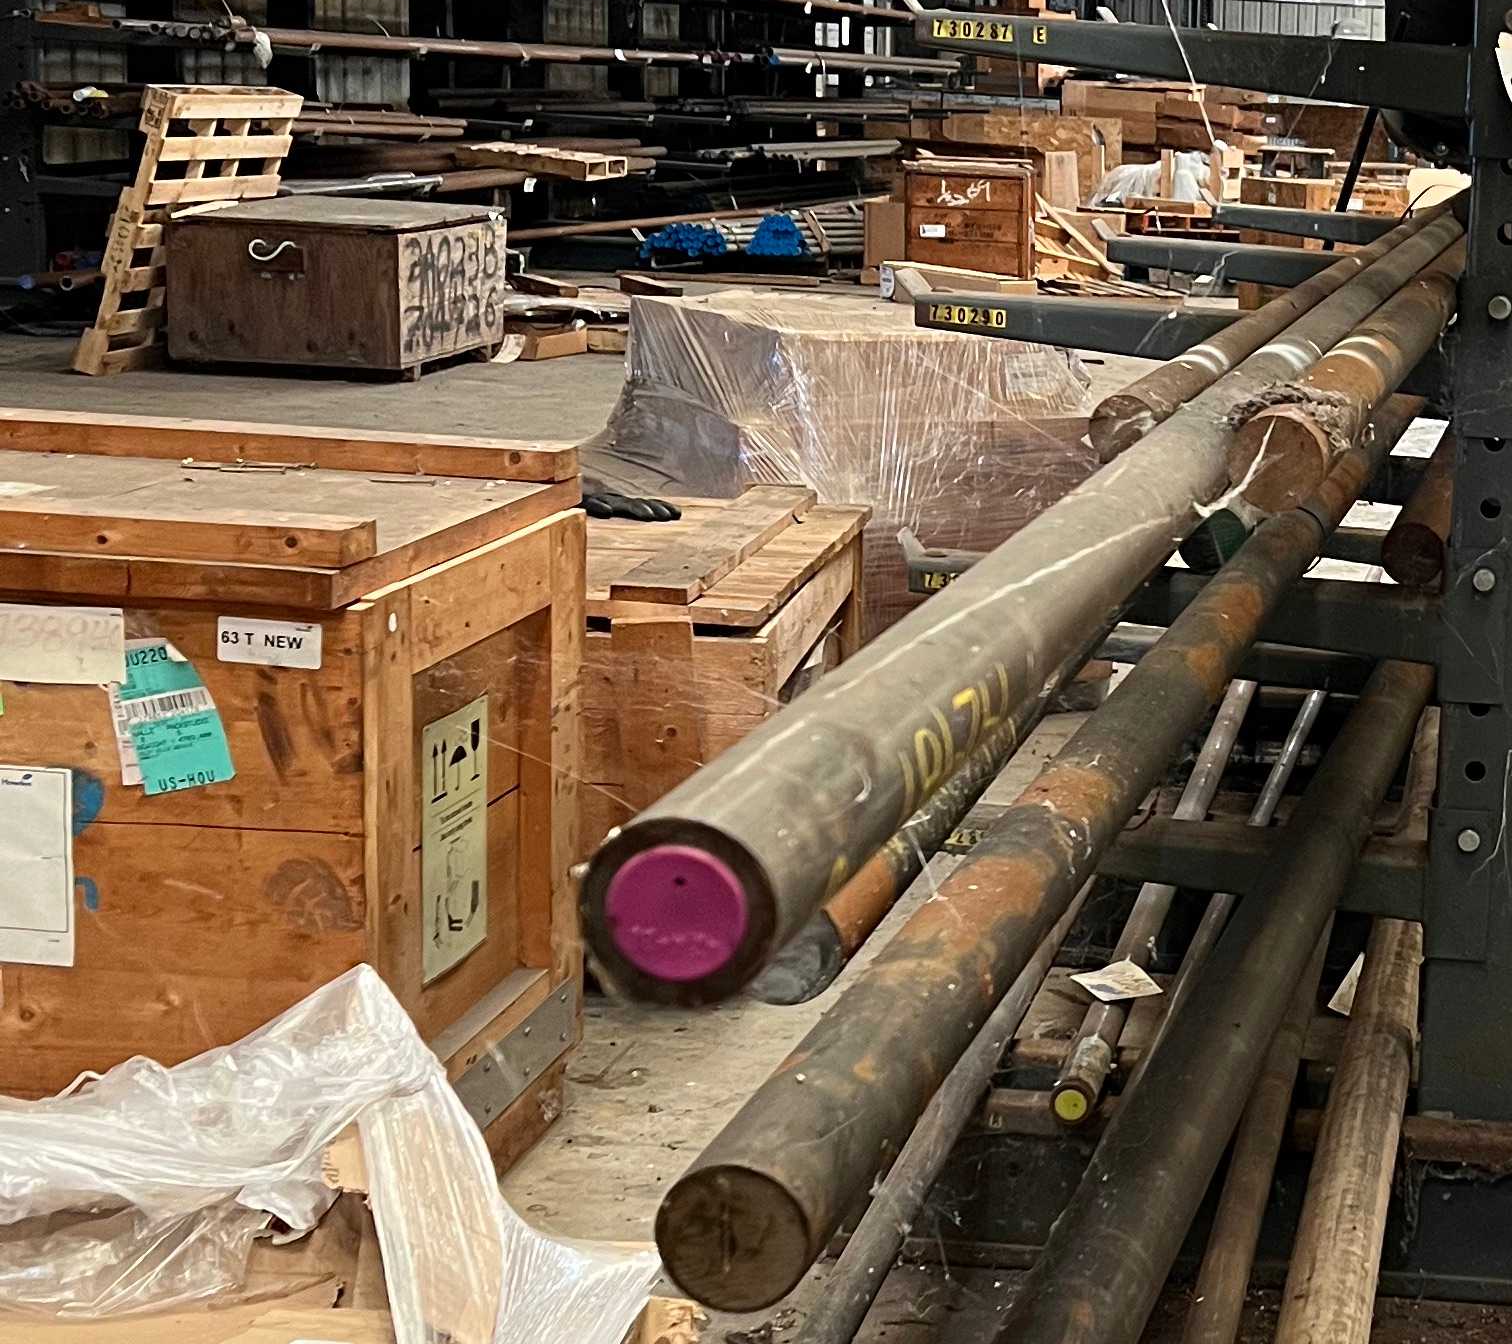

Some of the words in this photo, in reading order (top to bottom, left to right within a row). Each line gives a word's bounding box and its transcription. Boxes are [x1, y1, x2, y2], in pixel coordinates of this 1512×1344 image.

[935, 19, 1010, 40] 730287
[1036, 26, 1045, 43] E
[931, 304, 1004, 326] 730290
[221, 631, 239, 644] 63
[244, 632, 255, 645] T
[264, 634, 304, 649] NEW
[158, 770, 216, 792] US-HOU
